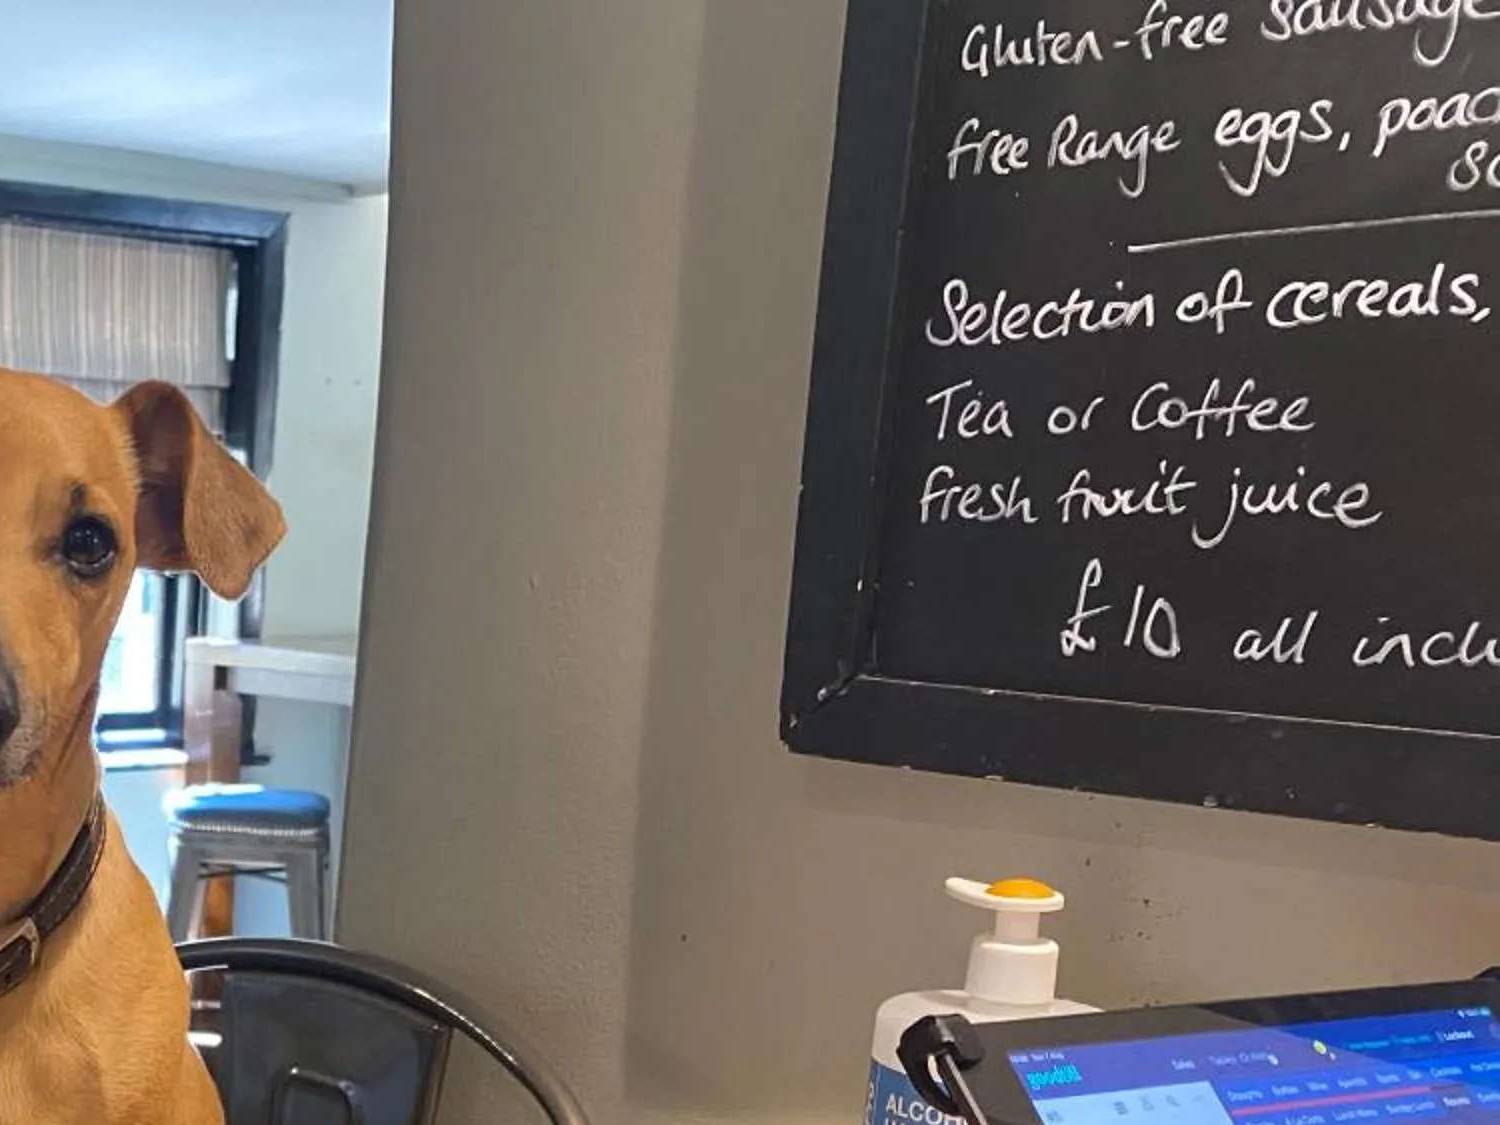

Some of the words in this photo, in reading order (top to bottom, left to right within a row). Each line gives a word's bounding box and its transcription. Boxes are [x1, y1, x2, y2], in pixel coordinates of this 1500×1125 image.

[1047, 113, 1181, 198] Range
[925, 278, 1155, 346] Selection
[1175, 268, 1253, 334] of
[926, 379, 1013, 440] Tea
[1047, 397, 1105, 434] or
[1131, 378, 1315, 440] Coffee
[1057, 459, 1197, 523] fruit
[1191, 465, 1383, 549] juice
[1233, 610, 1319, 664] all
